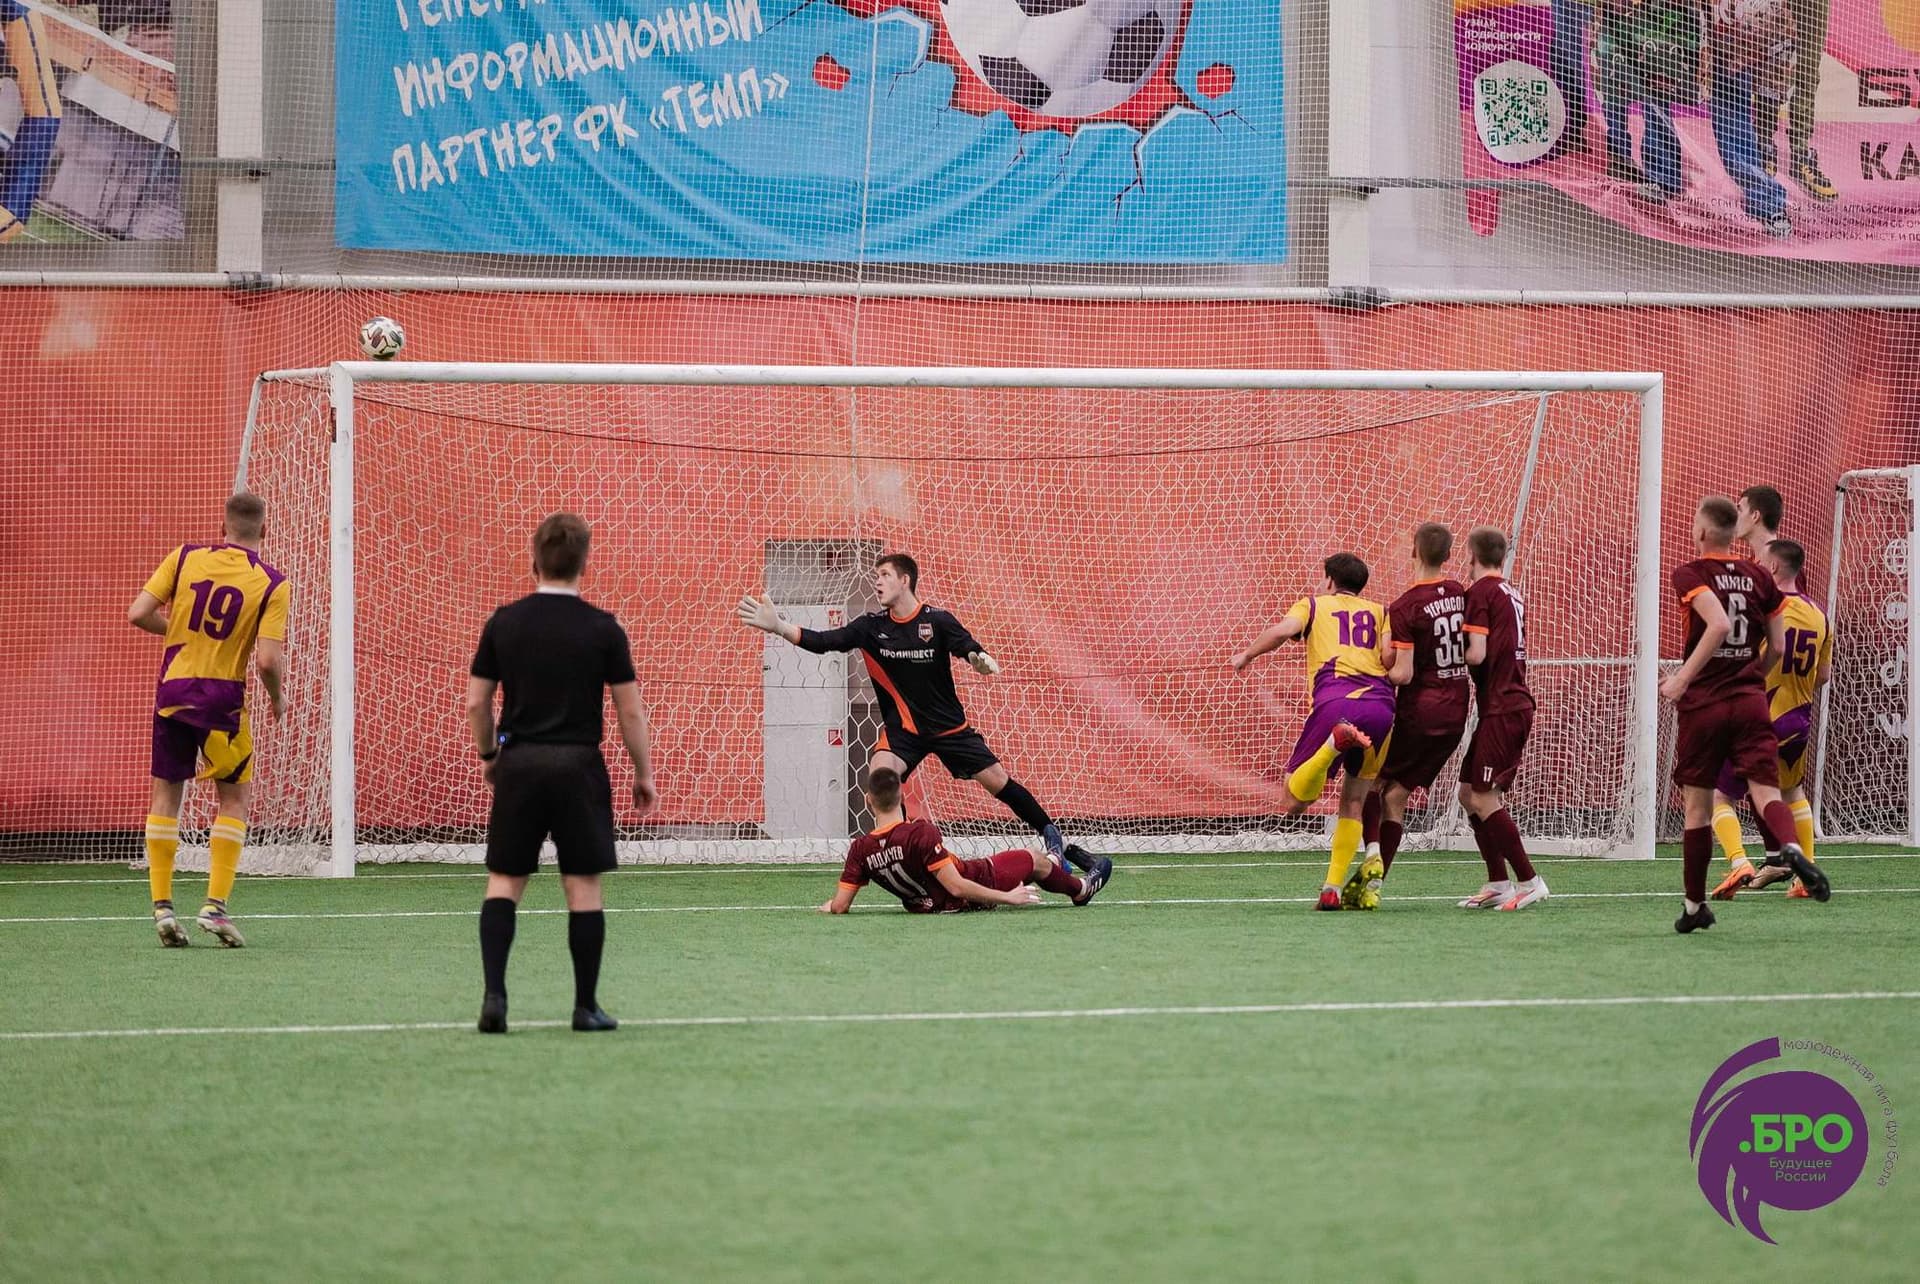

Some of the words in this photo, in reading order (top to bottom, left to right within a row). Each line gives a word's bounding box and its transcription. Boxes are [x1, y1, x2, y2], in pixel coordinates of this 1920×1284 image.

[1464, 30, 1541, 41] ПОДРОБНОСТИ
[1464, 42, 1517, 51] КОНКУРСА
[1858, 67, 1920, 109] Б
[392, 114, 561, 193] ПАРТНЕР
[573, 97, 639, 152] ФК
[649, 67, 790, 134] «ТЕМП»
[187, 579, 245, 641] 19
[1331, 611, 1378, 650] 18
[1726, 593, 1749, 645] 6
[1433, 612, 1465, 668] 33
[1781, 627, 1819, 678] 15
[866, 846, 904, 871] РОДИЧЕВ
